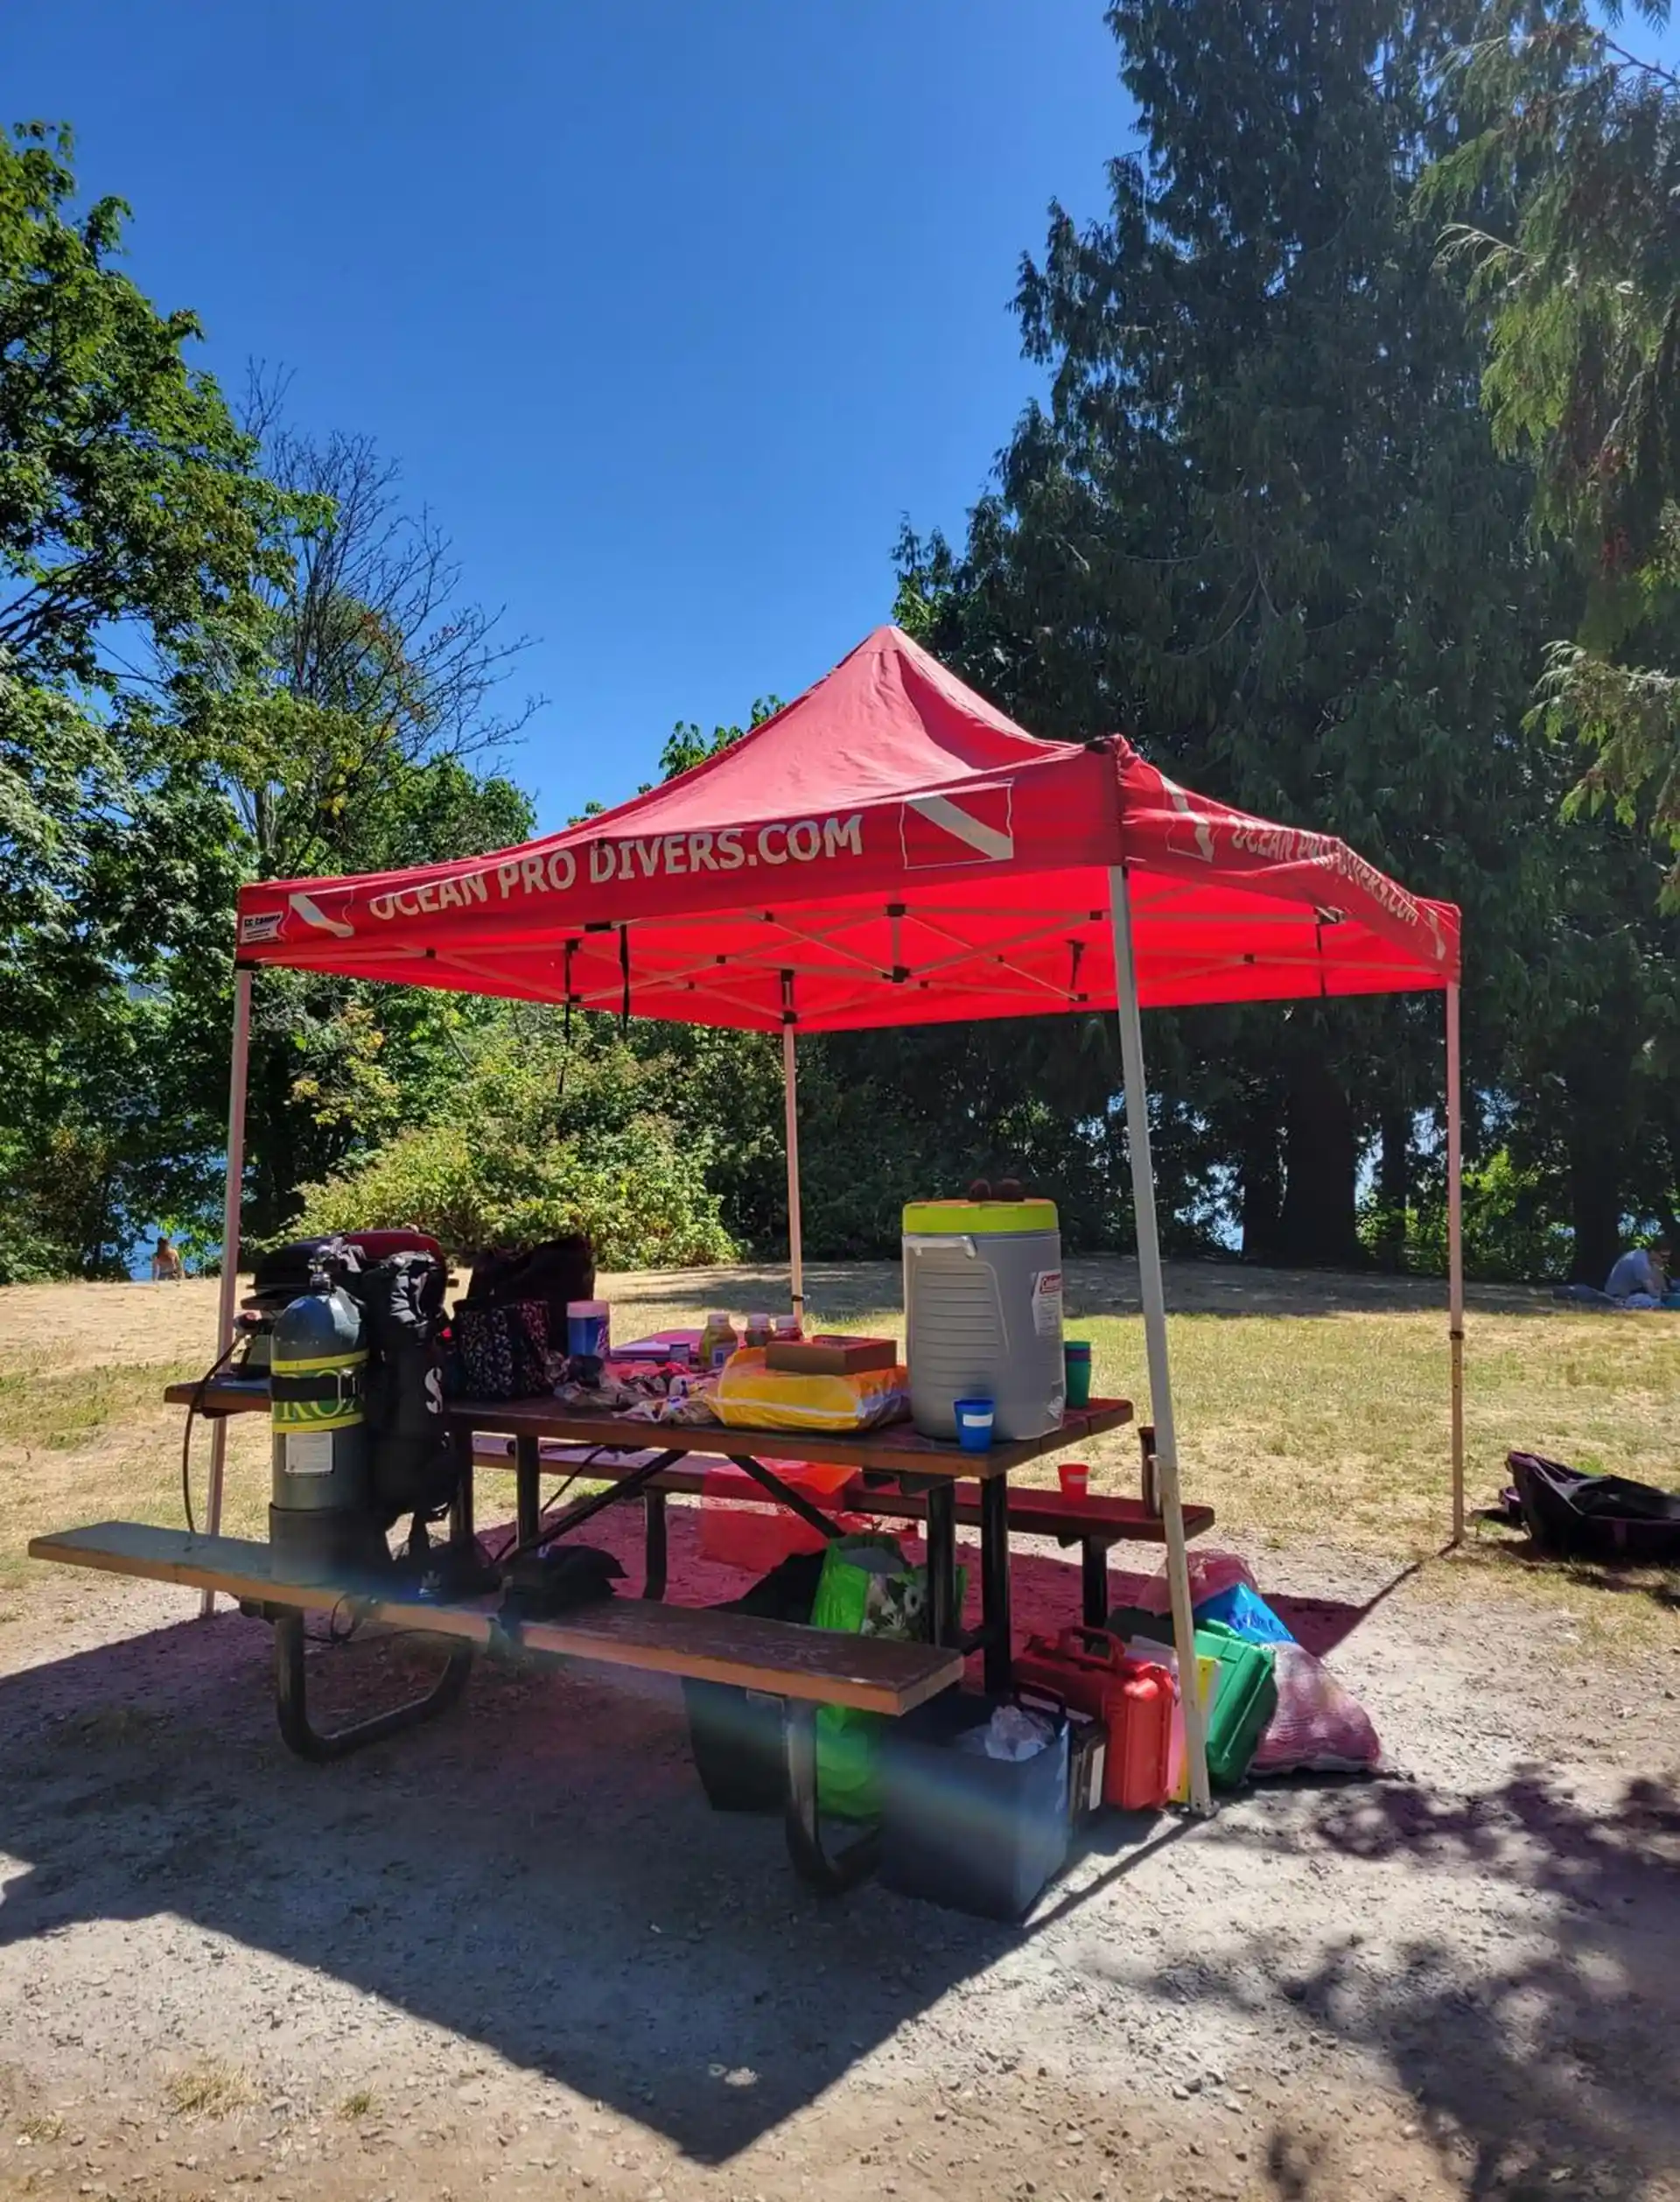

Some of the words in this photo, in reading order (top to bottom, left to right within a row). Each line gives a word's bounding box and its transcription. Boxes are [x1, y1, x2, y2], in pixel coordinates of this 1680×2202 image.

[369, 873, 488, 920] OCEAN
[497, 849, 577, 899] PRO
[590, 814, 864, 884] DIVERS.COM
